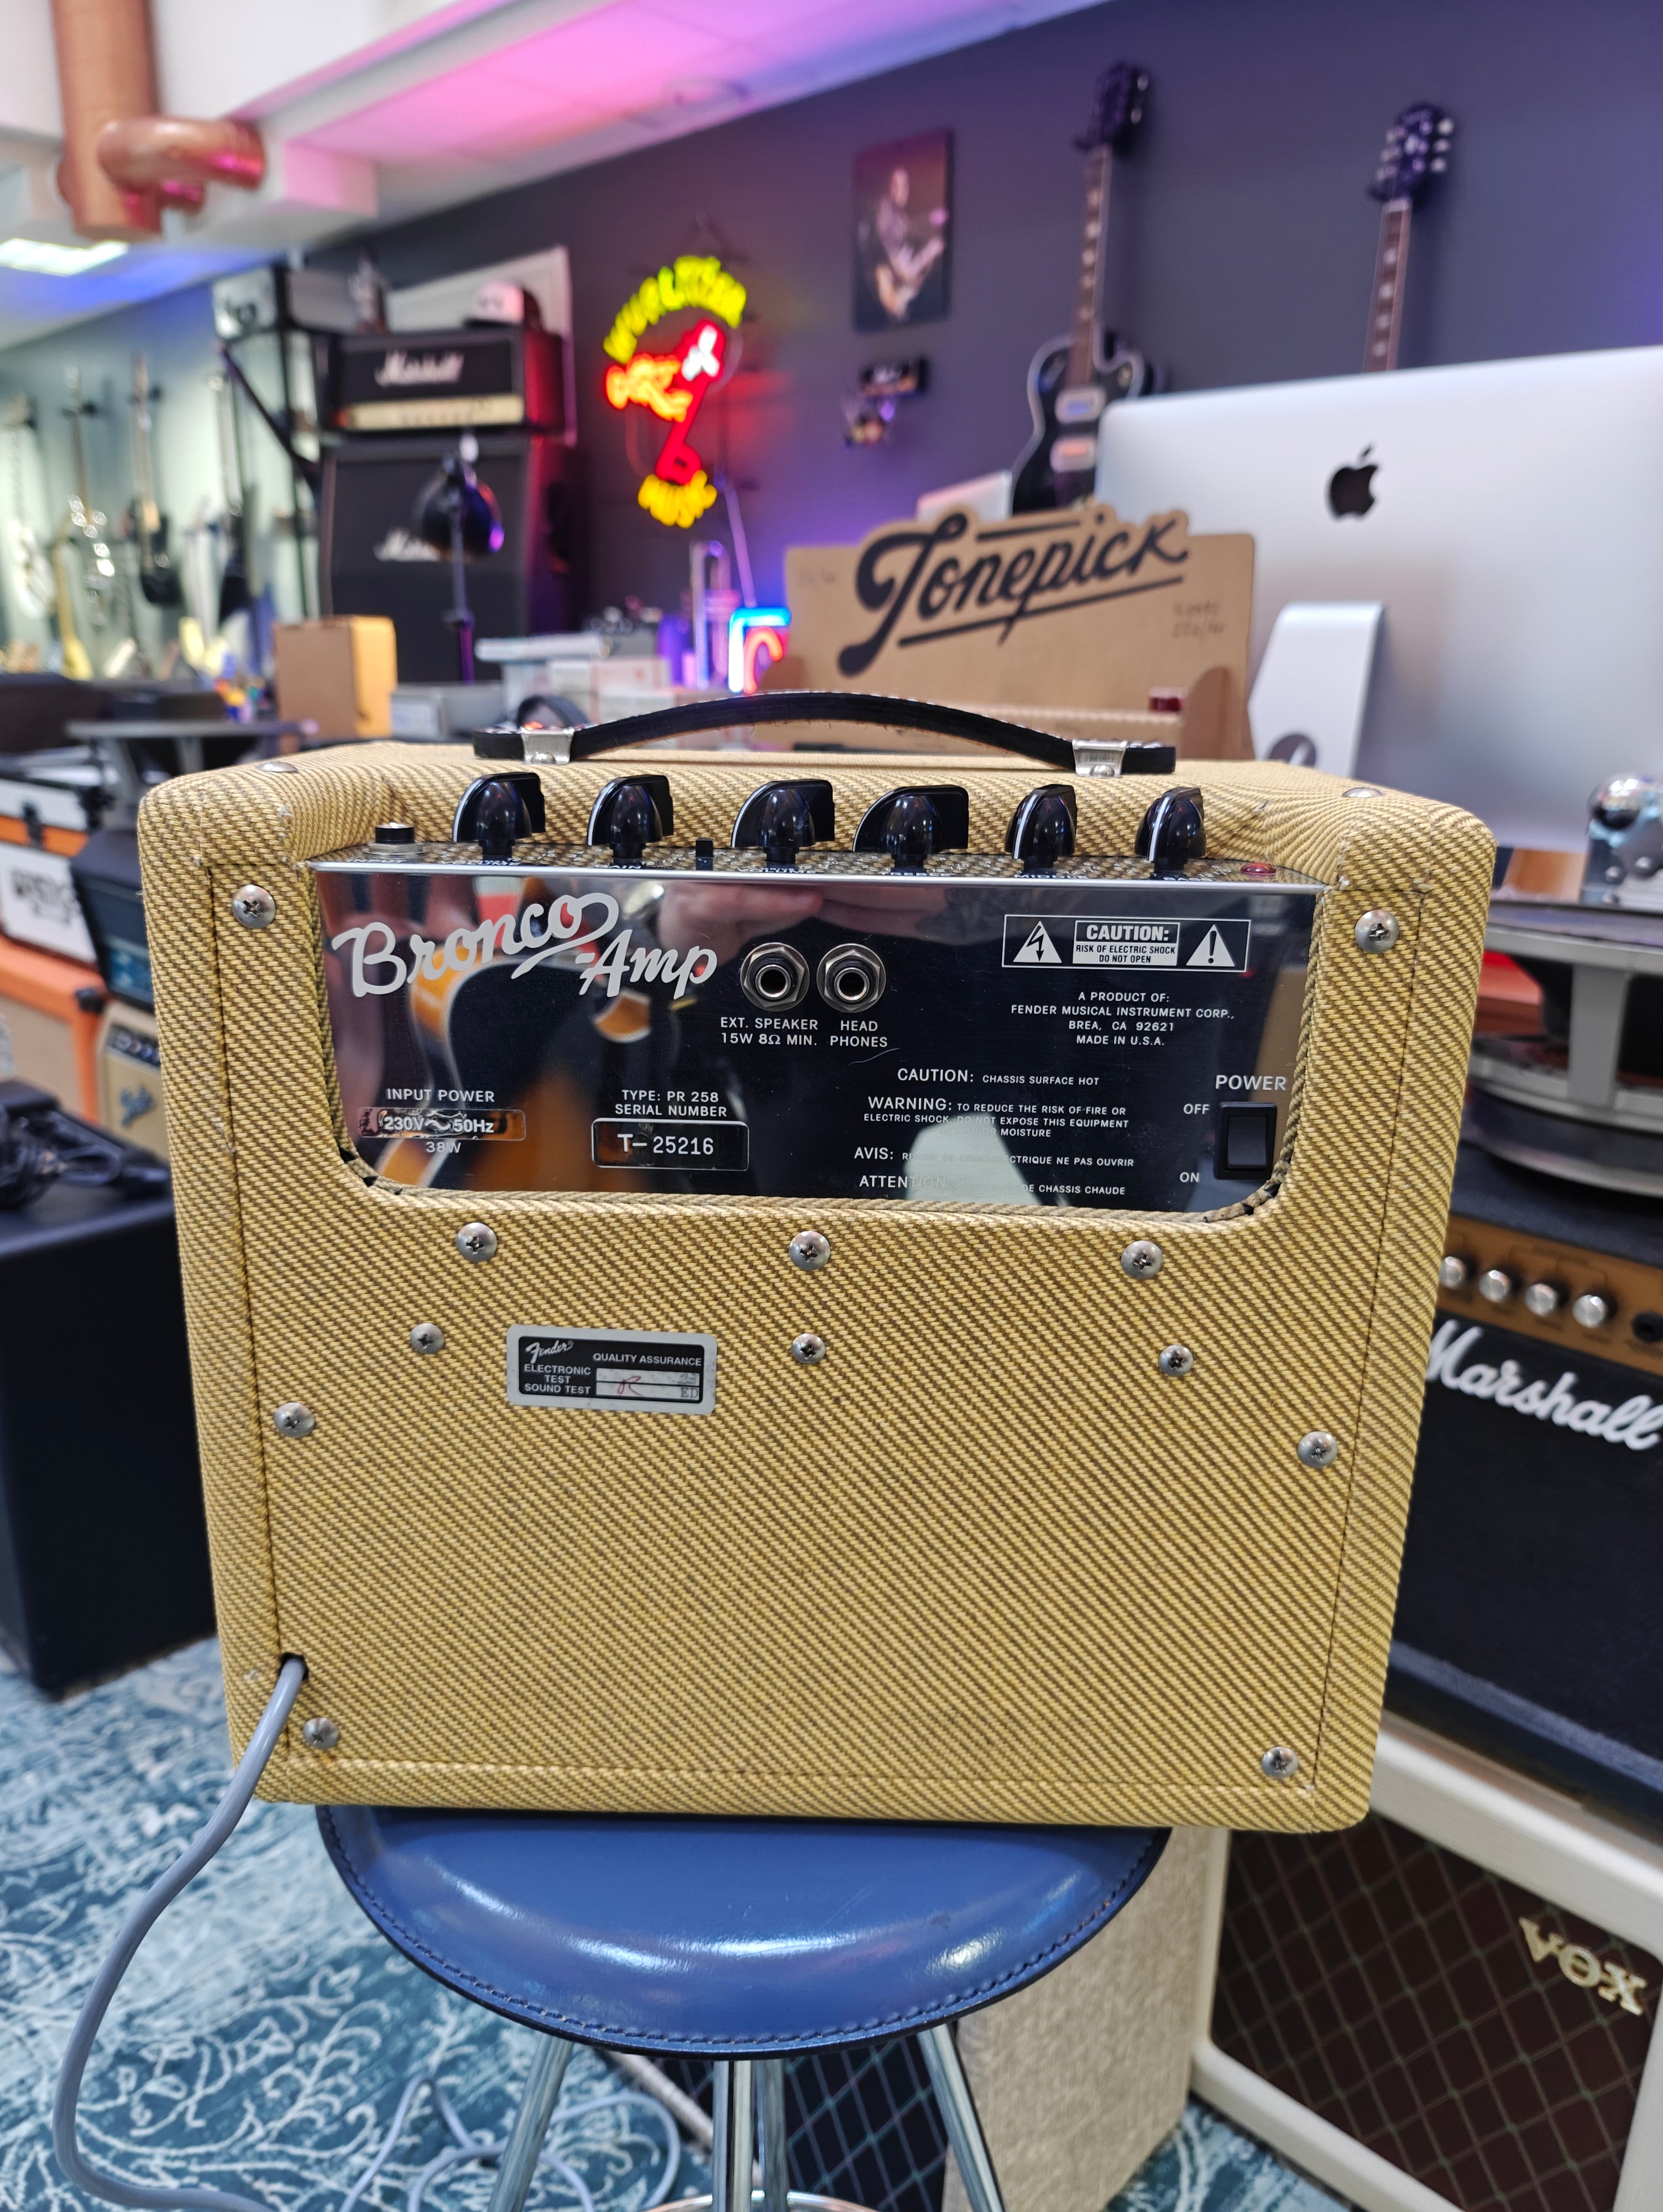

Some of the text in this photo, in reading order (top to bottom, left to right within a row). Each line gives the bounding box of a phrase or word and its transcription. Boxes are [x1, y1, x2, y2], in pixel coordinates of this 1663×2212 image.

[837, 510, 1189, 677] Tonepick
[1086, 925, 1169, 941] CAUTION:
[332, 893, 619, 997] Bronco
[1078, 993, 1169, 1003] A PRODUCT OF:
[1011, 1005, 1057, 1014] FENDER
[1061, 1006, 1112, 1016] MUSICAL
[1117, 1008, 1191, 1018] INSTRUMENT
[720, 1017, 818, 1030] EXT. SPEAKER
[840, 1020, 878, 1031] HEAD
[1069, 1021, 1174, 1031] BREA, CA 92621
[721, 1033, 754, 1044] 15W
[787, 1035, 817, 1045] MIN.
[830, 1036, 888, 1047] PHONES
[1076, 1036, 1165, 1046] MADE IN U.S.A.
[897, 1068, 1100, 1086] CAUTION: CHASSIS SURFACE HOT
[1215, 1075, 1287, 1091] POWER
[387, 1088, 495, 1103] INPUT POWER
[623, 1090, 719, 1103] TYPE: PR 258
[615, 1104, 727, 1117] SERIAL NUMBER
[868, 1097, 1126, 1115] WARNING: TO REDUCE THE RISK OF FIRE OR
[1183, 1104, 1210, 1114] OFF
[864, 1114, 911, 1122] ELECTRIC
[976, 1117, 996, 1125] NOT
[1000, 1117, 1039, 1125] EXPOSE
[1043, 1118, 1066, 1126] THIS
[1069, 1119, 1129, 1128] EQUIPMENT
[1001, 1129, 1052, 1138] MOISTURE
[426, 1141, 461, 1153] 38W
[854, 1147, 893, 1160] AVIS:
[1074, 1157, 1092, 1166] PAS
[1096, 1159, 1134, 1167] OUVRIR
[1179, 1172, 1200, 1183] ON
[1038, 1185, 1081, 1194] CHASSIS
[1084, 1186, 1125, 1195] CHAUDE
[525, 1340, 568, 1363] Fender
[593, 1353, 702, 1366] QUALITY ASSURANCE
[524, 1364, 592, 1375] ELECTRONIC
[545, 1375, 571, 1384] TEST
[525, 1384, 591, 1394] SOUND TEST
[1519, 1917, 1647, 2016] VOX
